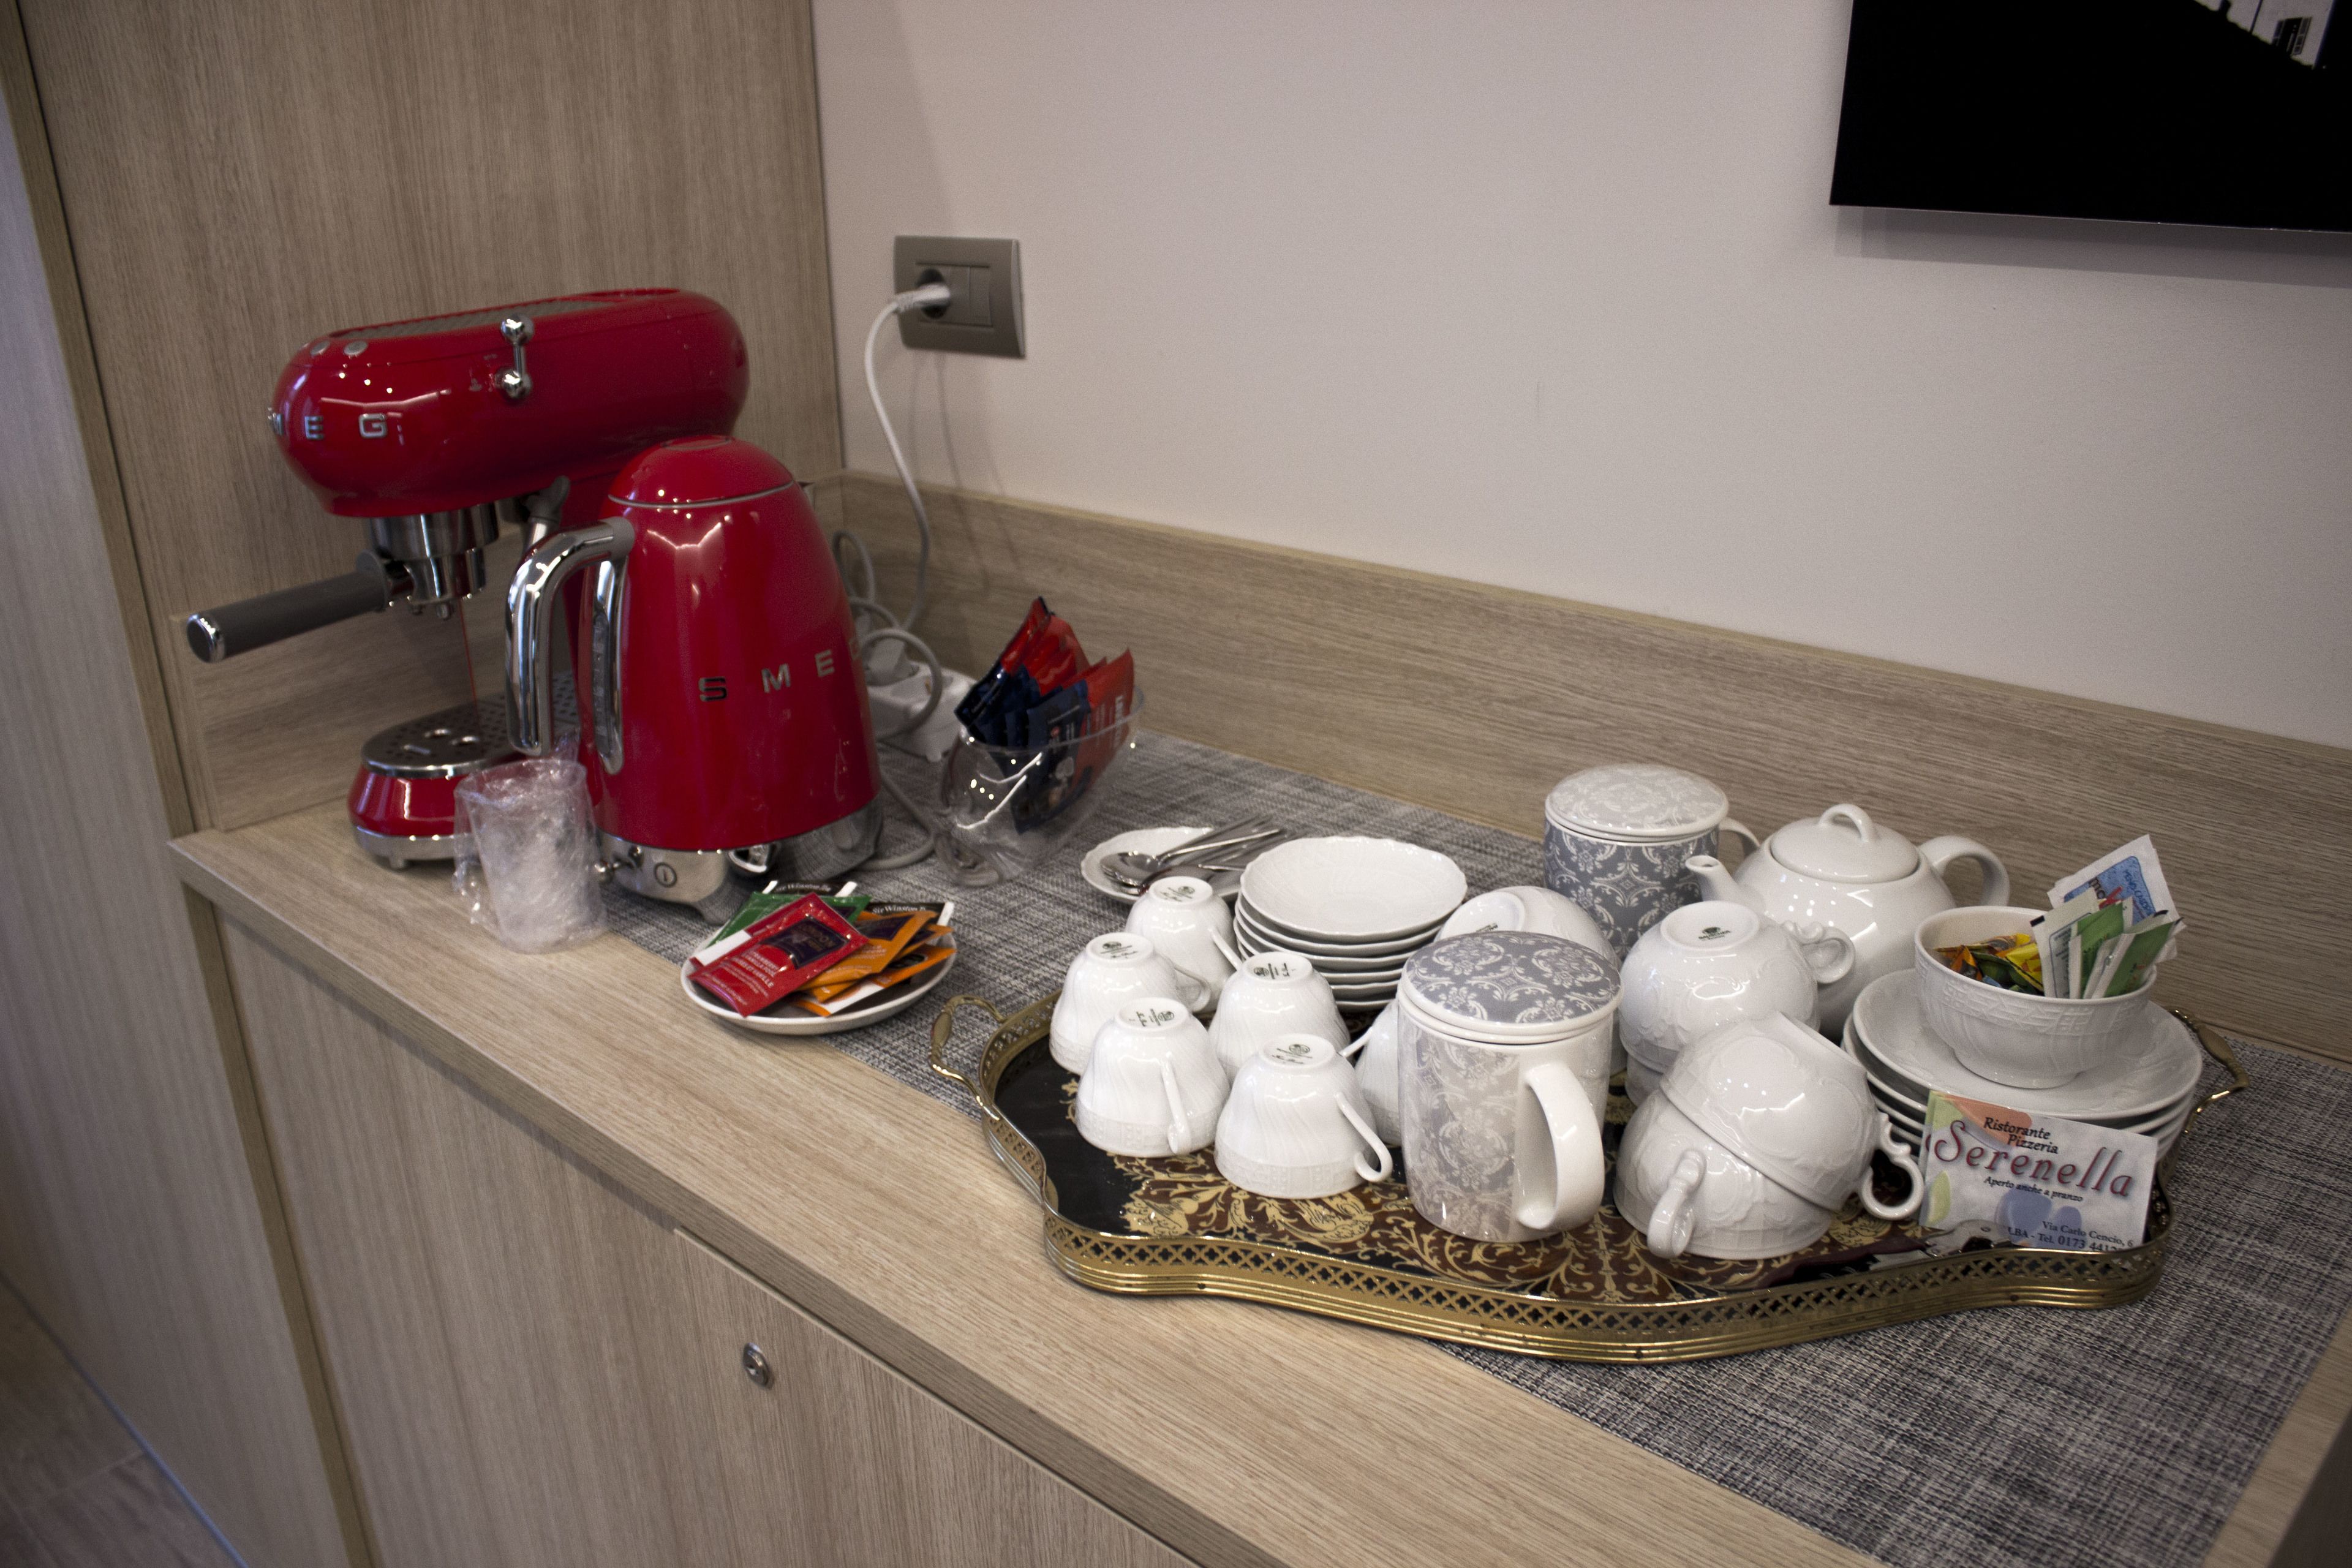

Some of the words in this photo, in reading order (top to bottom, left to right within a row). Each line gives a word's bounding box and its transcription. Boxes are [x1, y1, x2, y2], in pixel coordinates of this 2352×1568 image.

[1983, 1117, 2051, 1140] Ristorante
[2007, 1133, 2059, 1155] Pizzeria
[1934, 1120, 2133, 1197] Serenella
[1984, 1176, 2015, 1189] Aperto
[2016, 1183, 2043, 1194] anche
[2051, 1190, 2084, 1202] pranzo
[2008, 1226, 2029, 1239] LBA
[2057, 1235, 2086, 1250] 0173
[2042, 1221, 2058, 1232] Via
[2060, 1224, 2087, 1237] Carlo
[2127, 1239, 2135, 1248] 6
